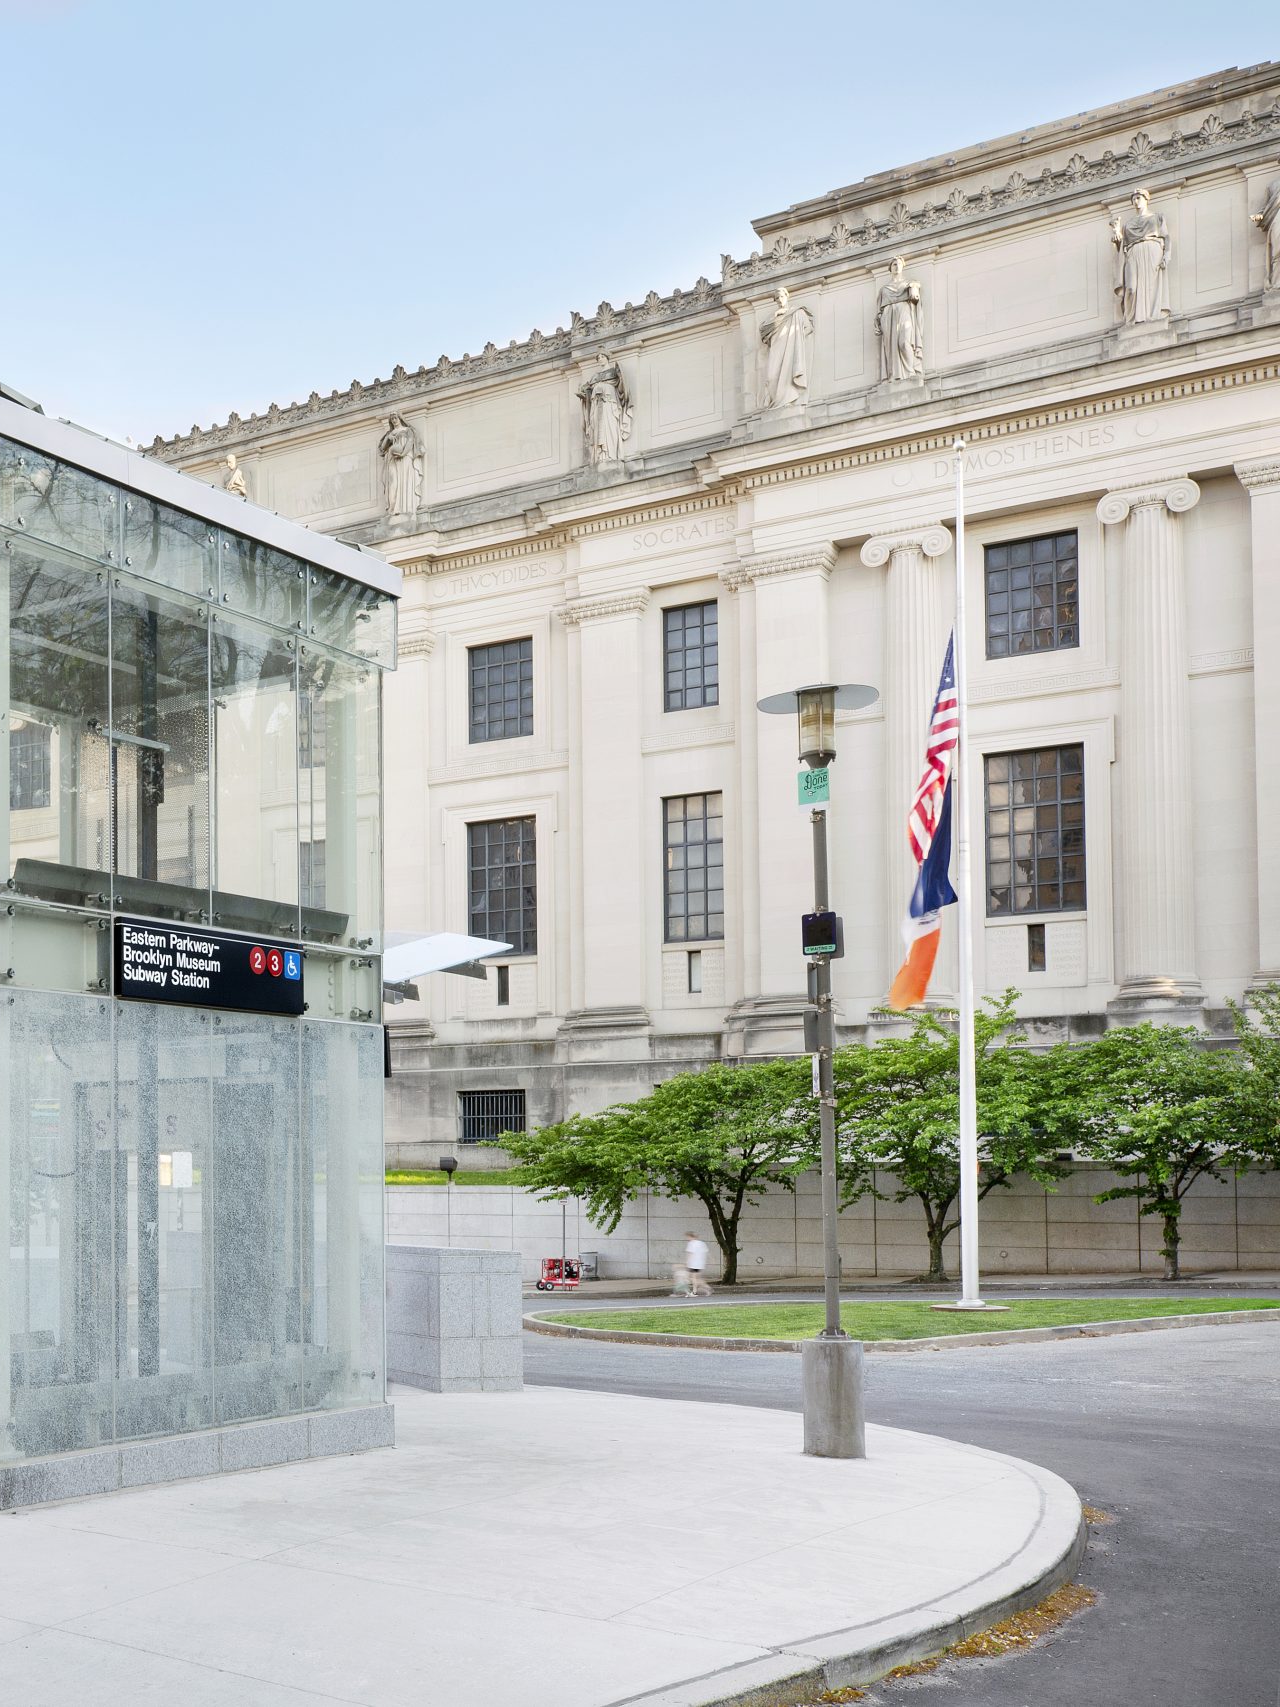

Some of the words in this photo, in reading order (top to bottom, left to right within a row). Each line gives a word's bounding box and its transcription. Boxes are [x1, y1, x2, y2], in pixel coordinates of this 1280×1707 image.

[631, 515, 736, 551] SOCRATES
[804, 773, 828, 790] Done
[123, 927, 166, 948] Eastern
[170, 934, 220, 957] Parkway-
[123, 945, 172, 967] Brooklyn
[176, 952, 220, 972] Museum
[254, 952, 262, 968] 2
[272, 956, 279, 971] 3
[123, 964, 167, 986] Subway
[171, 970, 210, 989] Station
